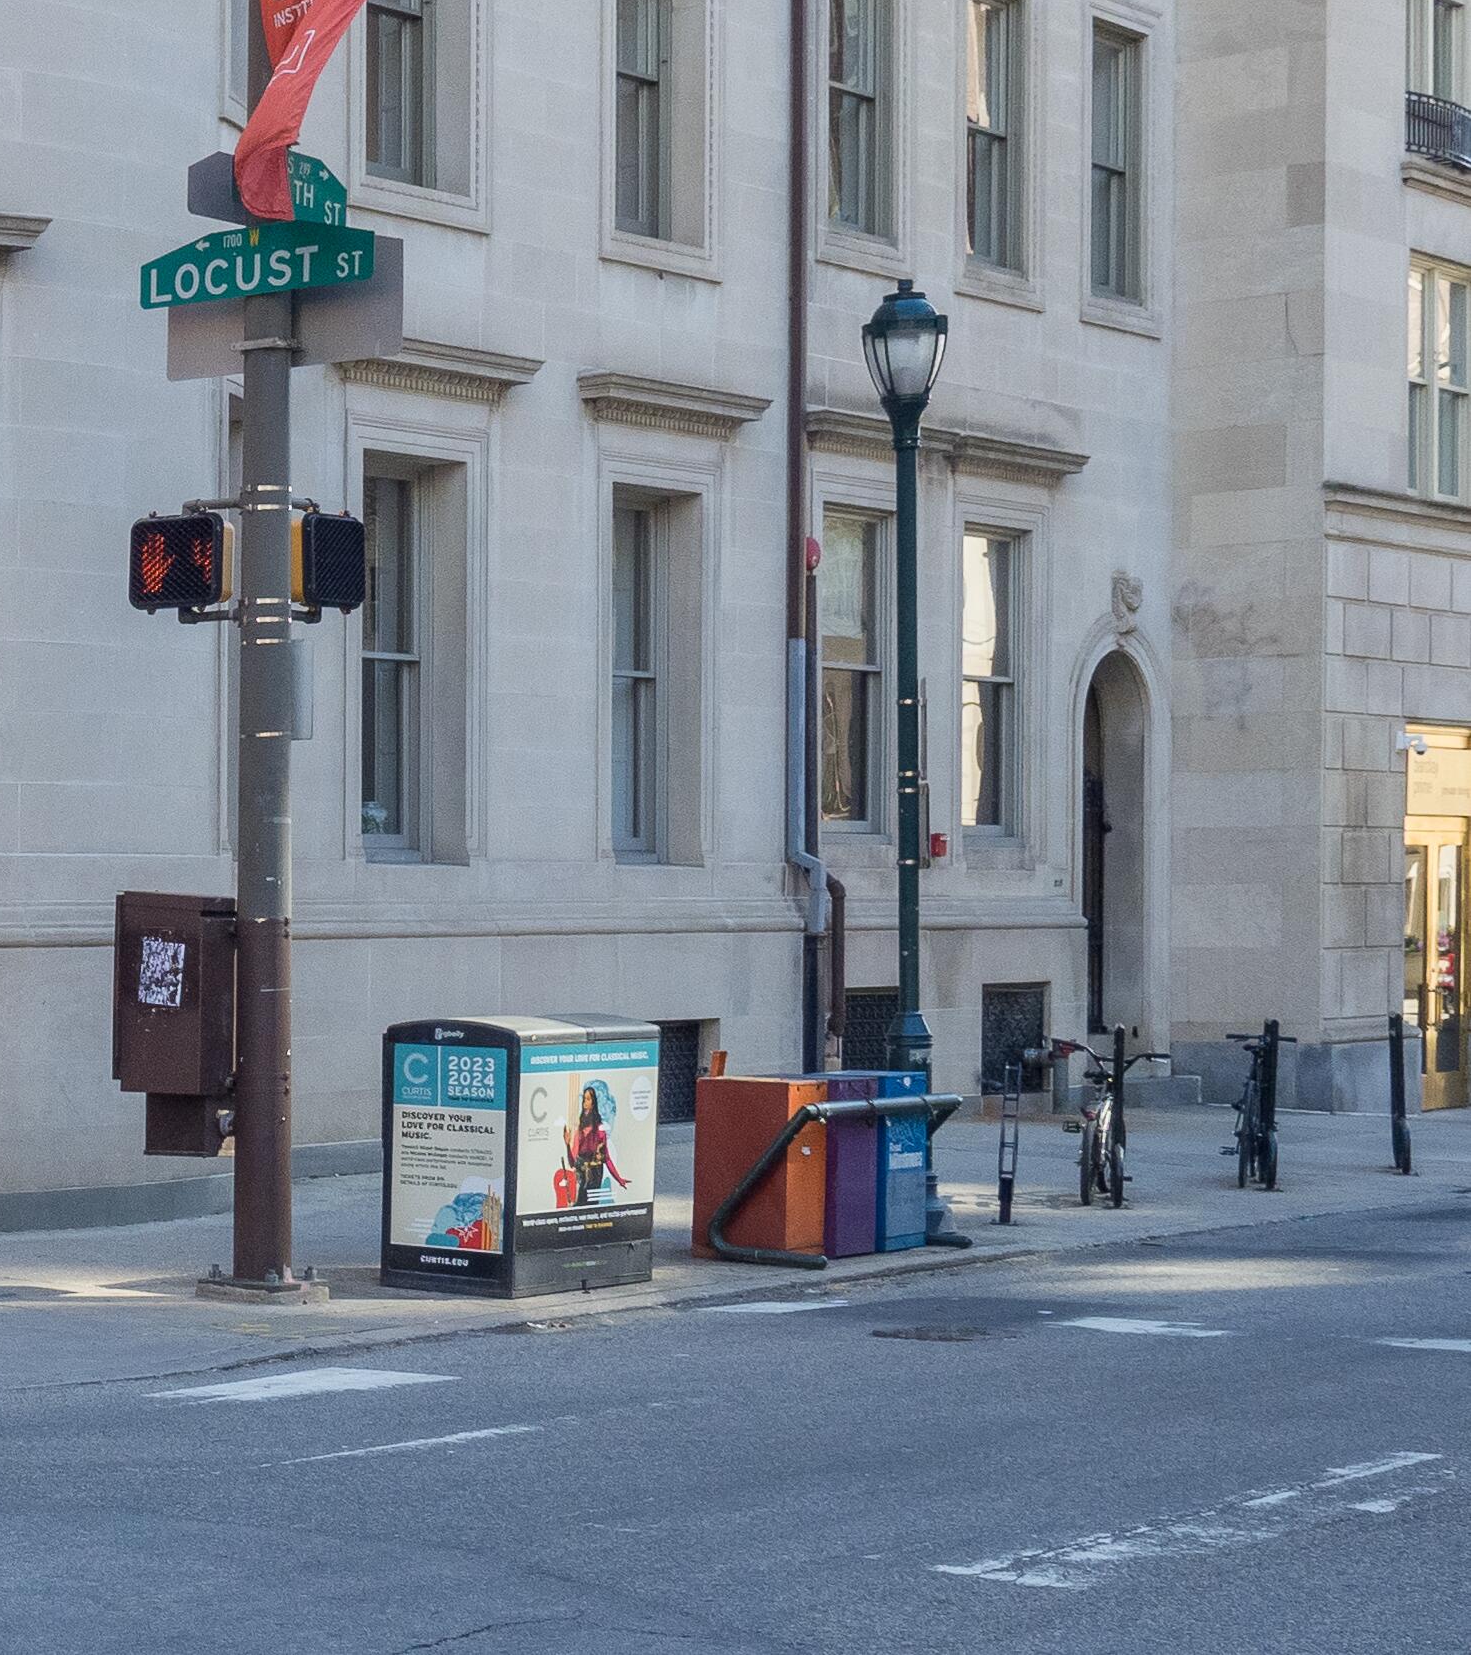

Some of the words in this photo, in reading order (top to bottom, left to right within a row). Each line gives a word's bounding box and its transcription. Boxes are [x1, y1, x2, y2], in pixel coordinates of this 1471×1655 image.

[323, 200, 342, 226] ST
[223, 233, 242, 248] 1700
[150, 245, 319, 304] LOCUST
[336, 250, 363, 278] ST
[448, 1055, 495, 1072] 2023
[448, 1071, 495, 1087] 2024
[401, 1086, 432, 1096] CURTIS
[447, 1086, 495, 1099] SEASON
[401, 1111, 446, 1121] DISCOVER
[448, 1114, 473, 1123] YOUR
[401, 1121, 424, 1130] LOVE
[427, 1122, 444, 1131] FOR
[446, 1124, 495, 1135] CLASSICAL
[401, 1131, 432, 1140] MUSIC.
[420, 1254, 469, 1266] CURTIS.EDU
